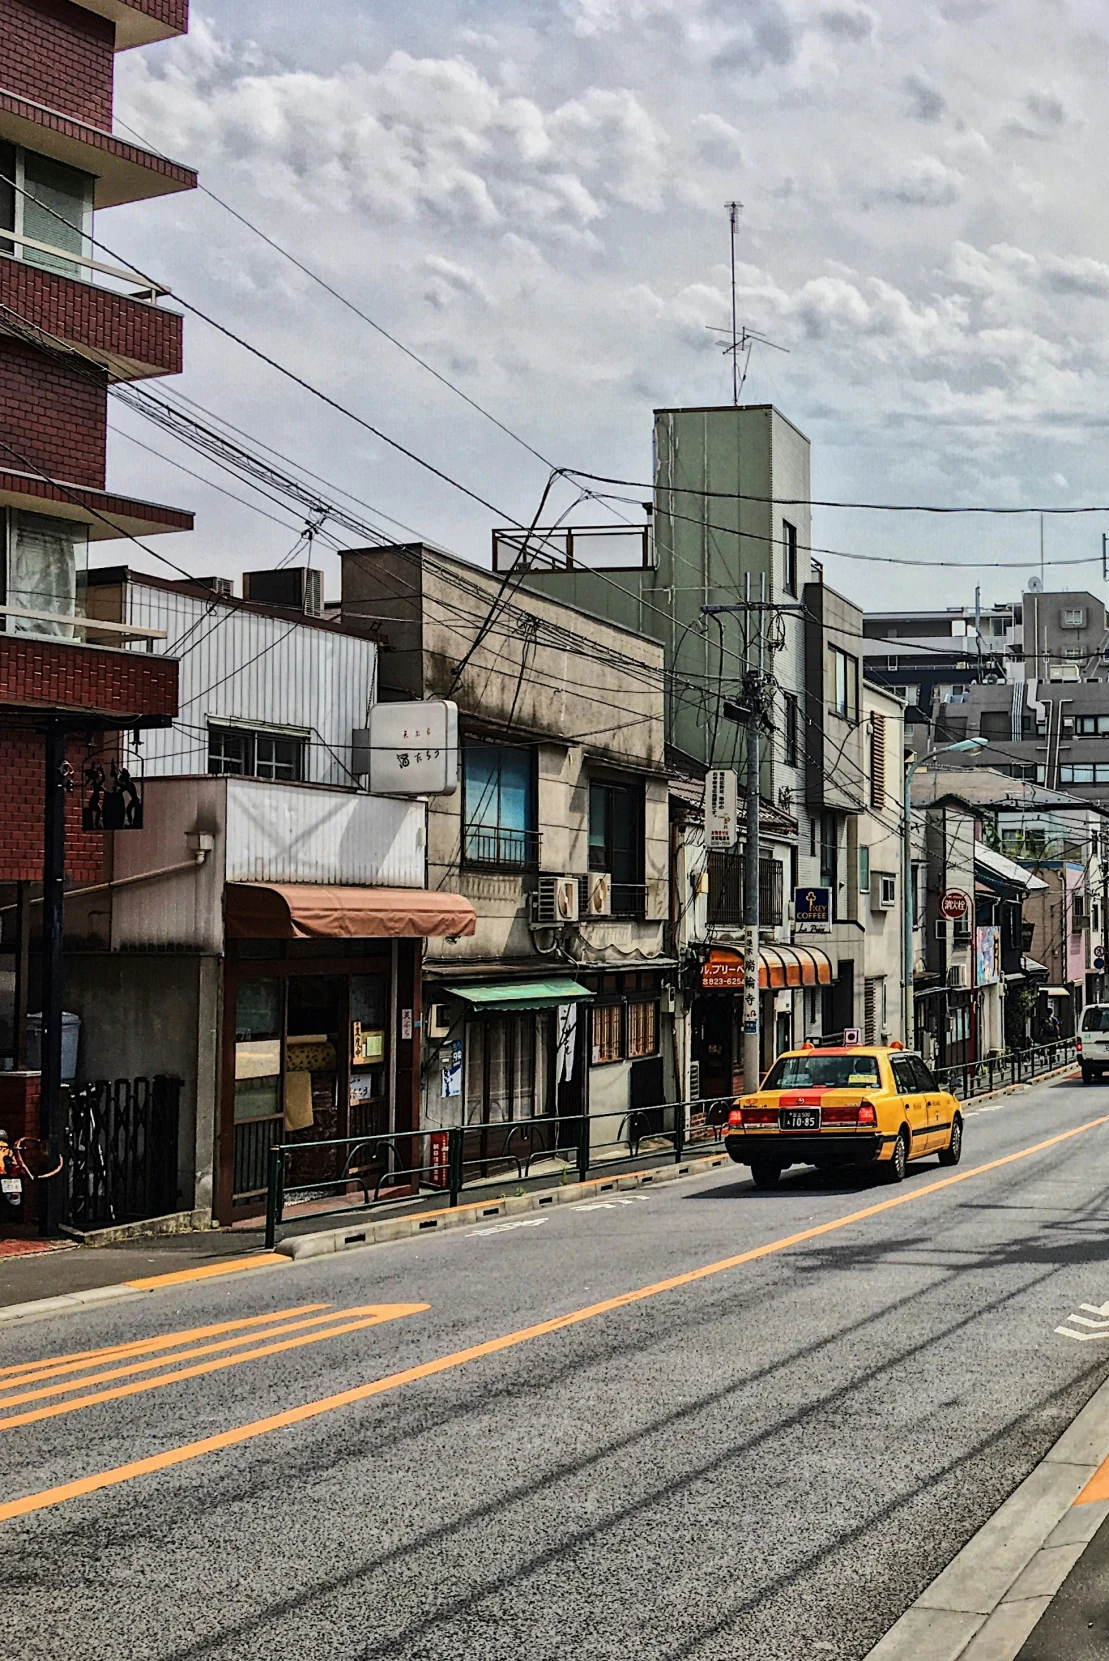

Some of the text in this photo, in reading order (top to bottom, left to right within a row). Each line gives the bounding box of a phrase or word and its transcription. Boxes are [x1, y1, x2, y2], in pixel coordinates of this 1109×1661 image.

[944, 900, 966, 911] 消火栓
[792, 1117, 815, 1127] 10-85
